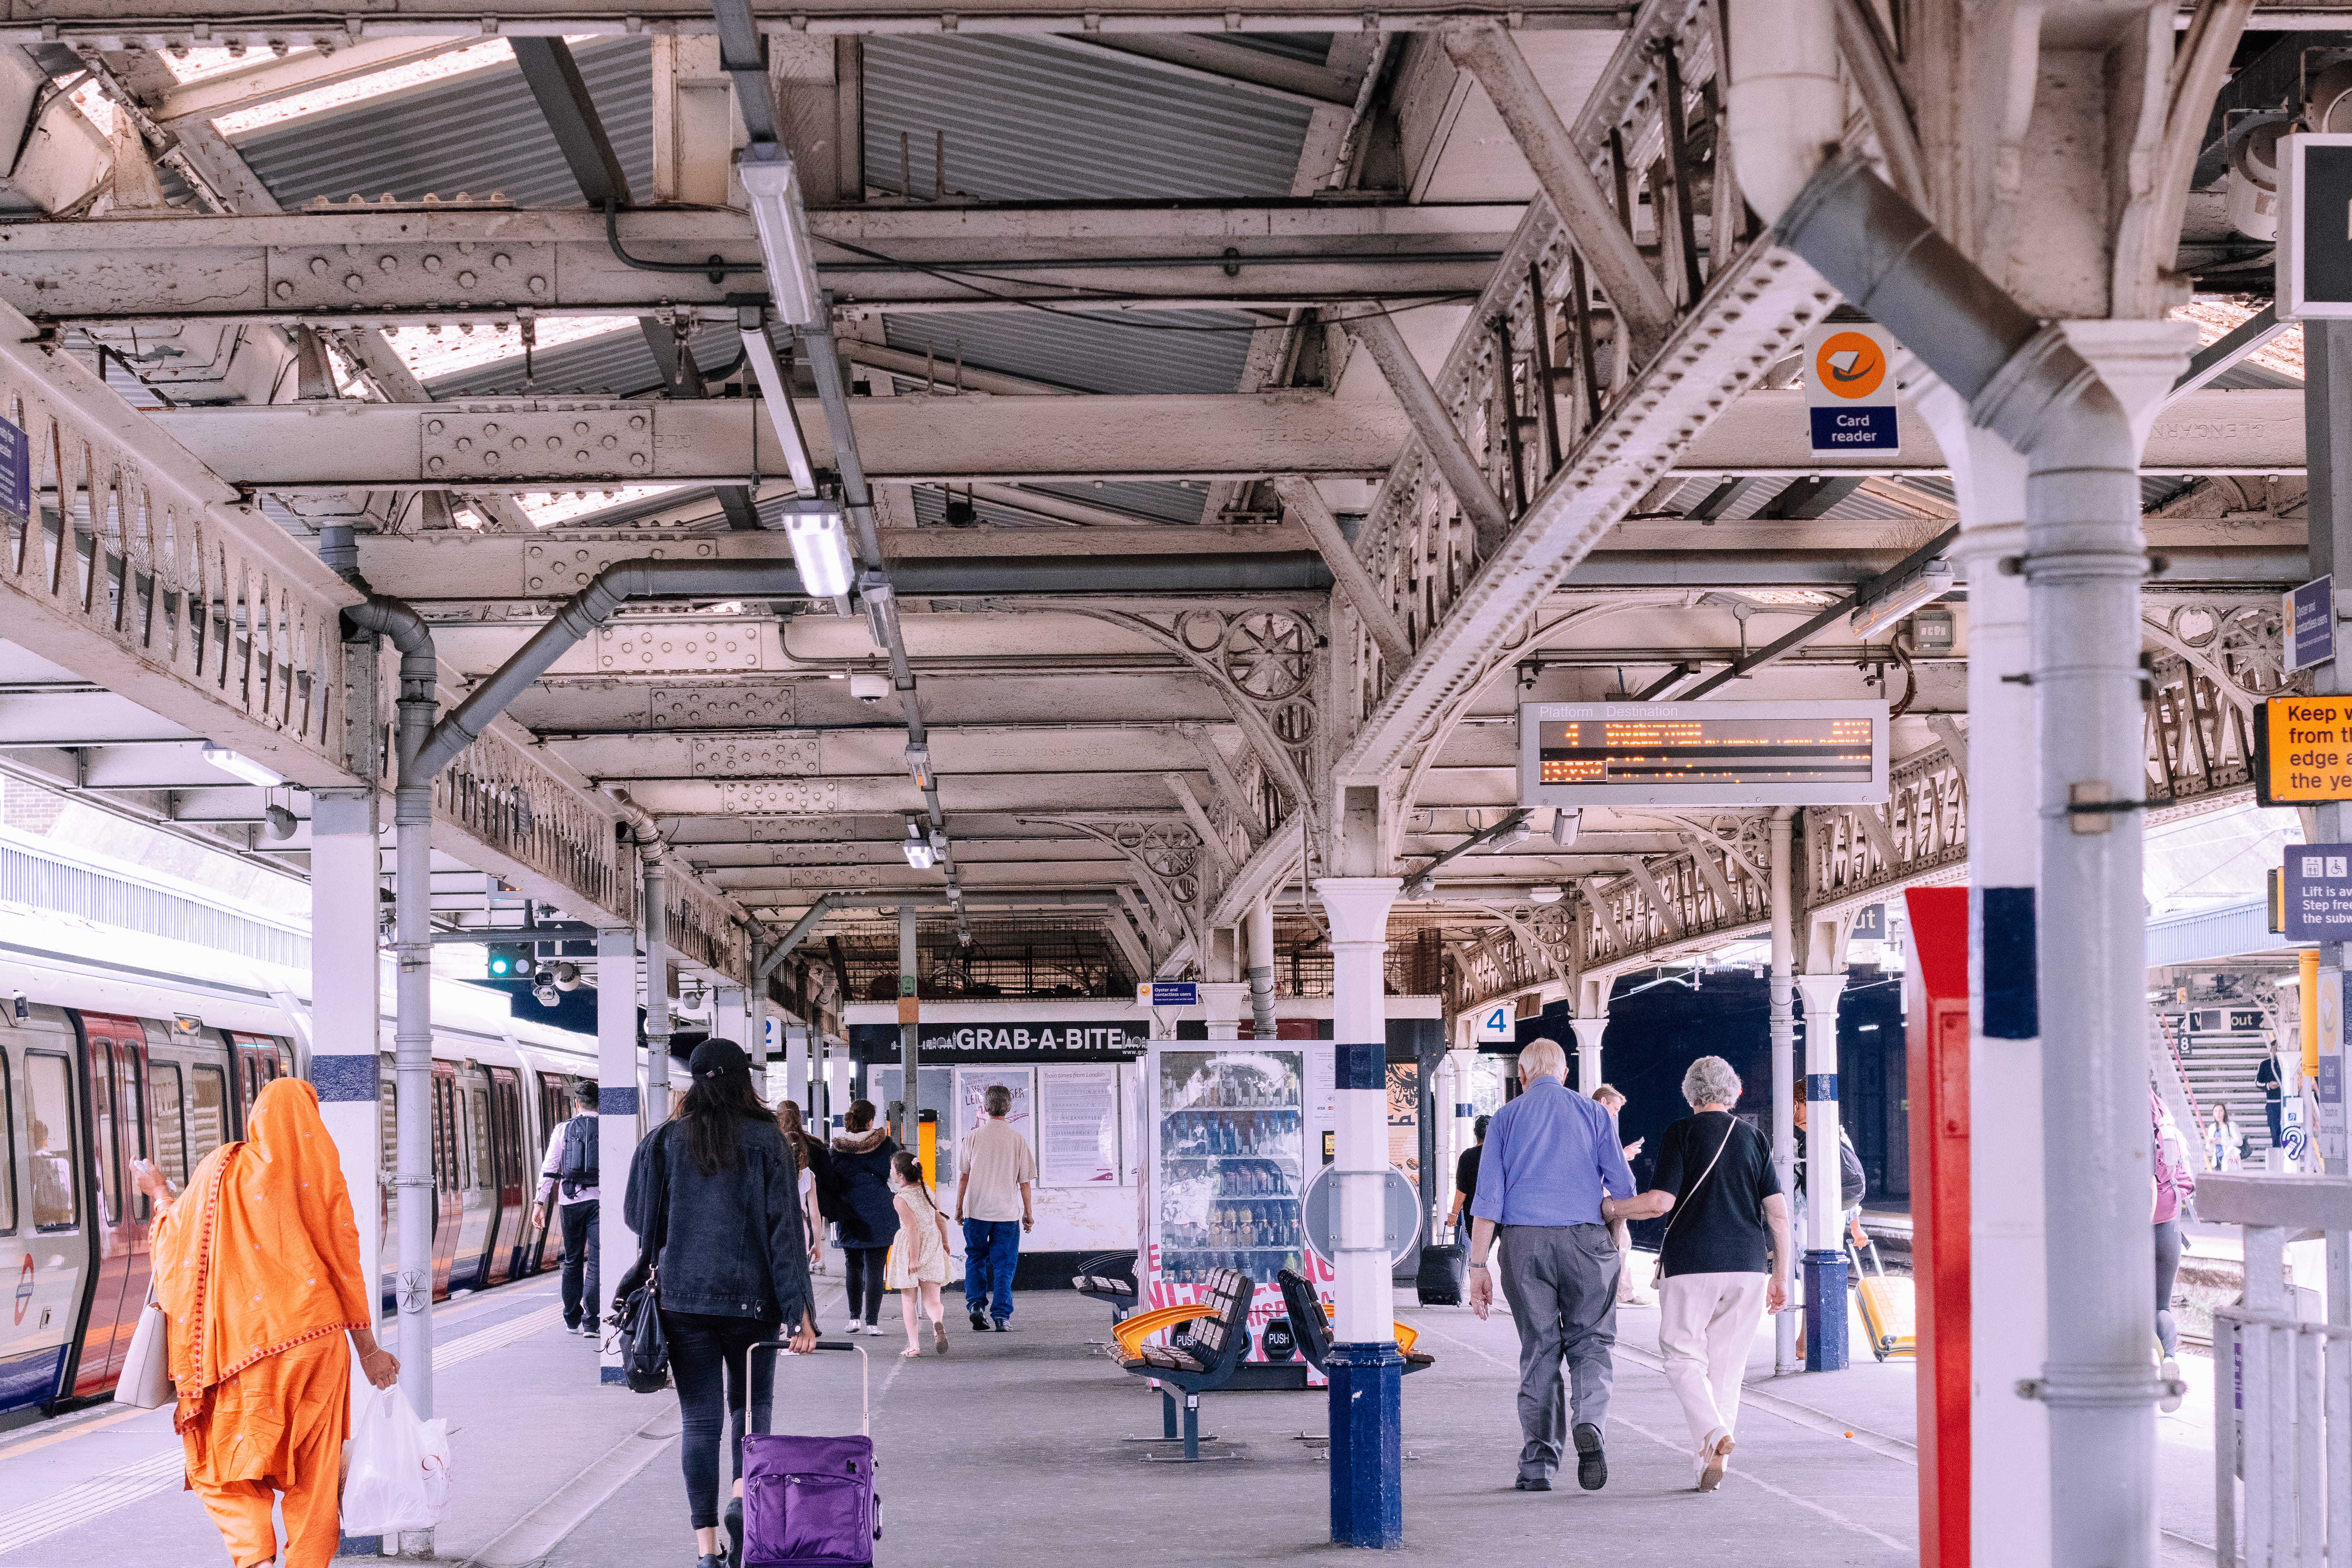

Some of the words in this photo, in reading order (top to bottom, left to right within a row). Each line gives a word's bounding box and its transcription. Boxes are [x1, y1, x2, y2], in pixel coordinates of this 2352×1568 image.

[1837, 415, 1869, 426] Card
[1832, 430, 1877, 442] reader
[1540, 706, 1593, 717] Platform
[1607, 705, 1678, 717] Destination
[2288, 706, 2337, 724] Keep
[2289, 728, 2334, 744] from
[2341, 727, 2352, 743] t
[2290, 750, 2338, 769] edge
[2291, 773, 2321, 788] the
[2330, 775, 2352, 791] ye
[2302, 886, 2323, 897] Lift
[2326, 886, 2336, 897] is
[2303, 900, 2329, 911] Step
[2303, 913, 2322, 924] the
[1487, 1009, 1506, 1033] 4
[2231, 1014, 2252, 1026] out
[956, 1029, 1122, 1050] GRAB-A-BITE
[2181, 1037, 2189, 1051] 8
[1176, 1335, 1197, 1346] PUSH
[1269, 1334, 1289, 1344] PUSH
